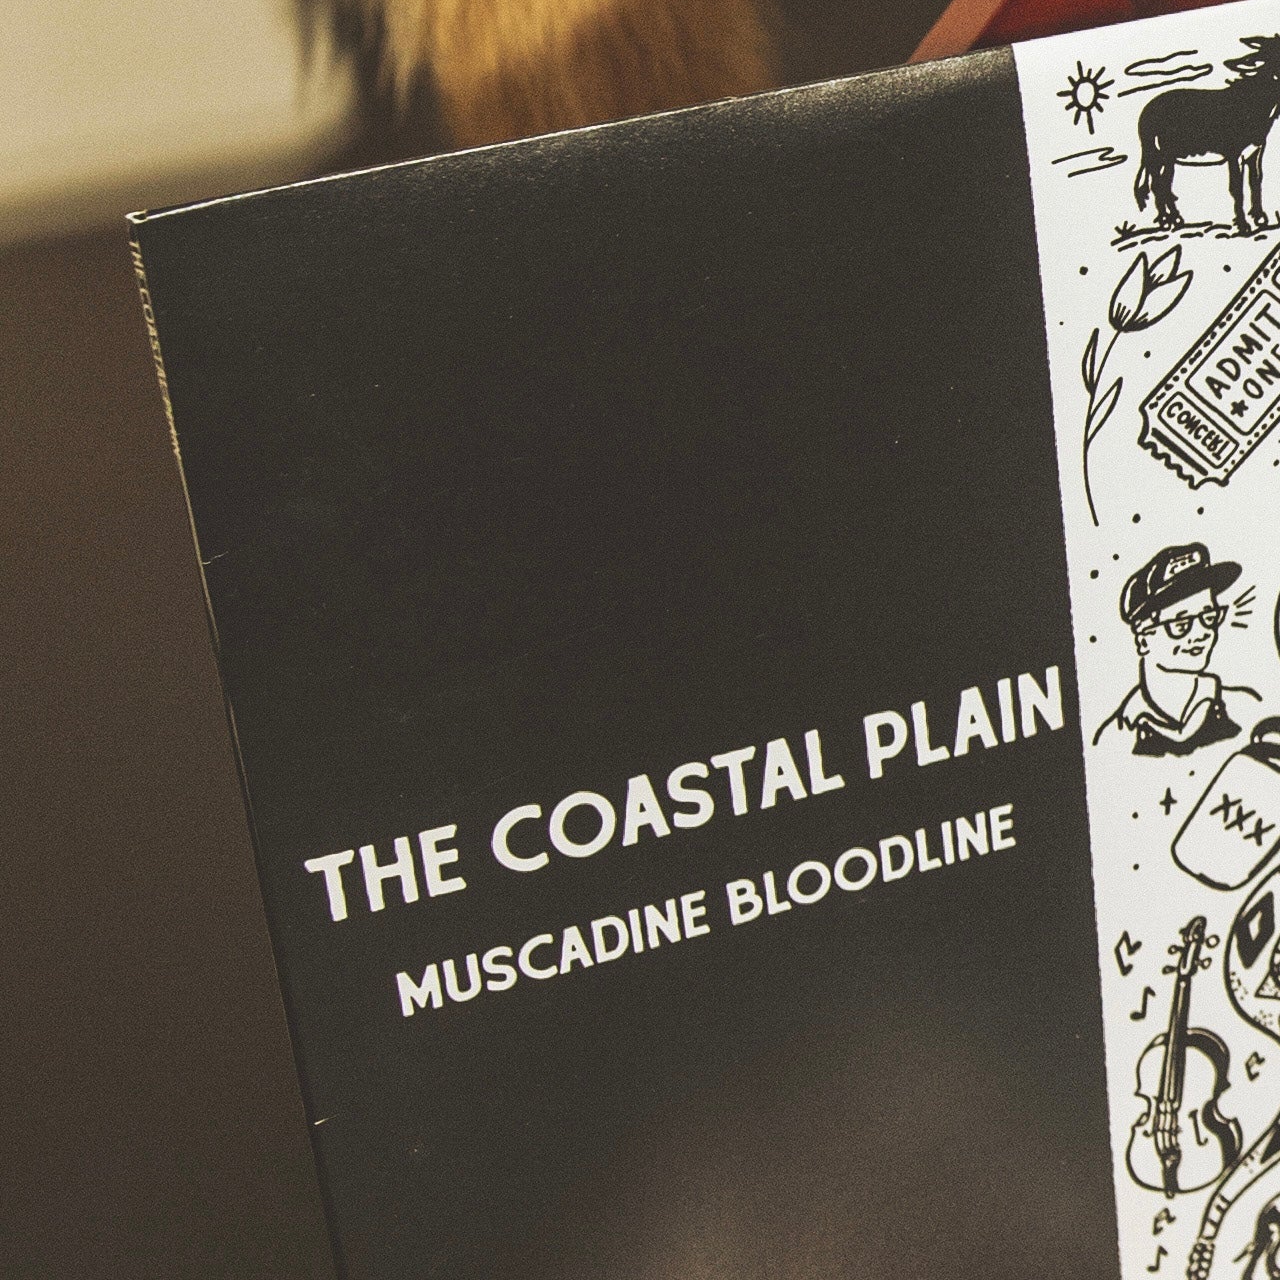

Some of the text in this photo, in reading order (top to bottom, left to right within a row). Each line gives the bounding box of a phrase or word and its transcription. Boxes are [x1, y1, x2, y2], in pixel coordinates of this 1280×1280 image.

[304, 665, 1064, 922] THE COASTAL PLAIN
[1209, 793, 1276, 847] XXX
[395, 803, 1017, 1018] MUSCADINE BLOODLINE
